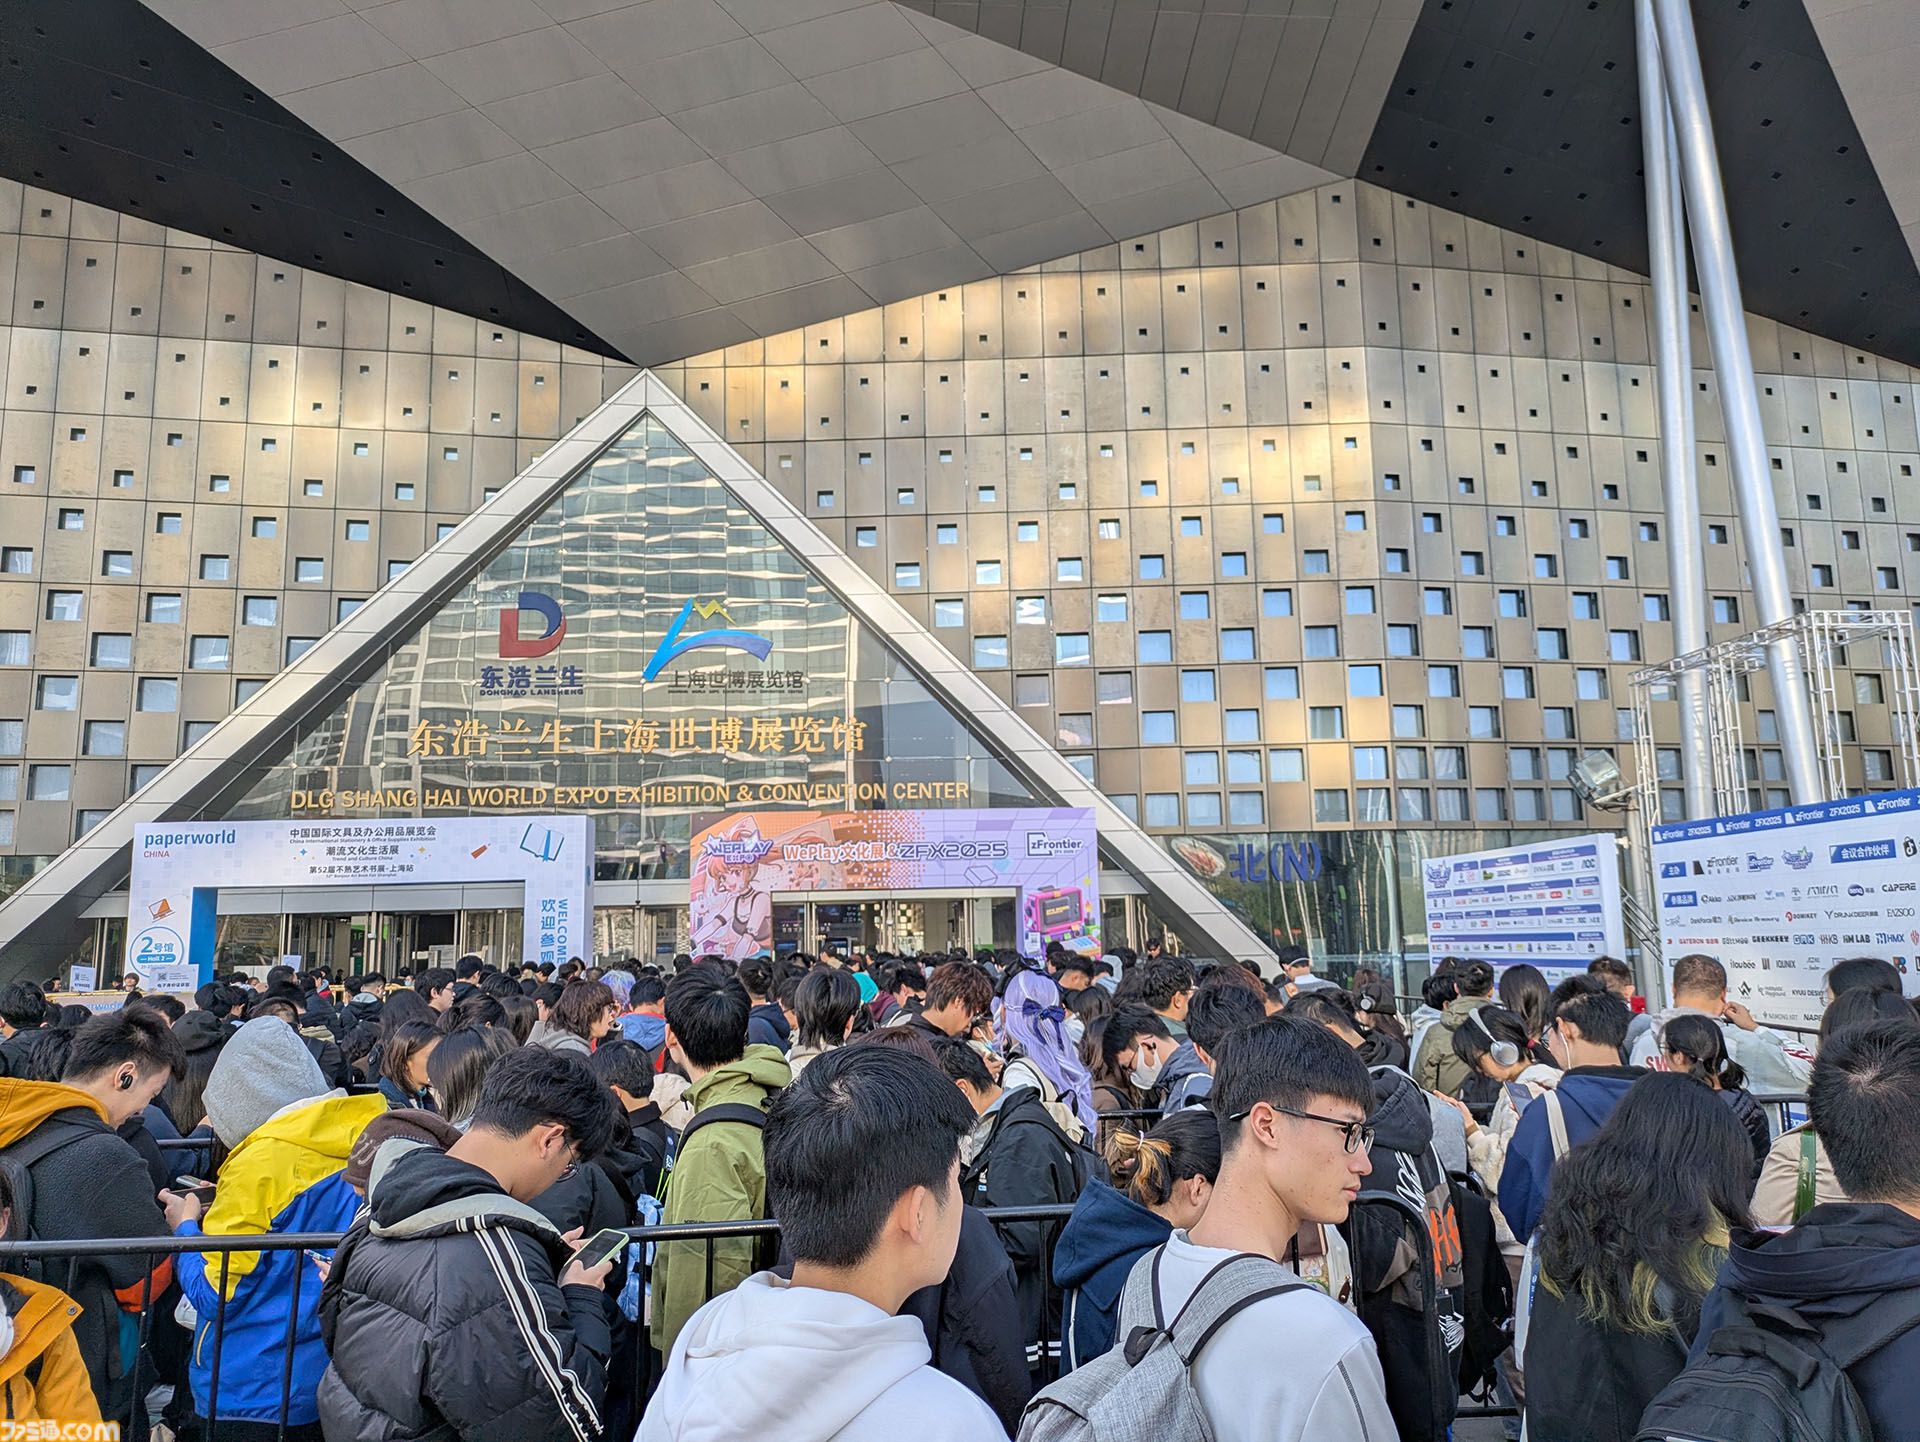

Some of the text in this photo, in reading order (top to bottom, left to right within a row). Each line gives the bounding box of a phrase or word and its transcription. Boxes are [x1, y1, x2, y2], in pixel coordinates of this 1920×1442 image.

[480, 665, 583, 689] 东浩兰生
[668, 670, 804, 689] 上海世博展览馆
[406, 717, 868, 757] 东浩兰生上海世博展览馆
[290, 782, 969, 809] DLG SHANG HAI WORLD EXPO EXHIBITION & CONVENTION CENTER
[1877, 797, 1911, 810] zFrontier
[1795, 809, 1825, 822] zFrontier
[1829, 804, 1860, 817] ZFX2025
[1725, 820, 1750, 831] zFrontier
[1754, 816, 1782, 827] ZFX2025
[290, 825, 437, 838] 中国国际文具及办公用品展览会
[144, 829, 236, 848] paperworld
[1031, 840, 1082, 850] zFrontier
[144, 850, 170, 858] CHINA
[326, 845, 399, 856] 潮流文化生活展
[706, 841, 771, 854] WEPLAY
[784, 844, 885, 862] WePlay文化展
[901, 844, 1007, 858] ZFX2025
[1706, 856, 1739, 867] zFrontier
[1882, 882, 1917, 892] CAPERE
[557, 898, 568, 964] WELCOME
[1855, 934, 1871, 943] LAB
[1887, 933, 1905, 943] HMX
[140, 936, 174, 954] 2号馆
